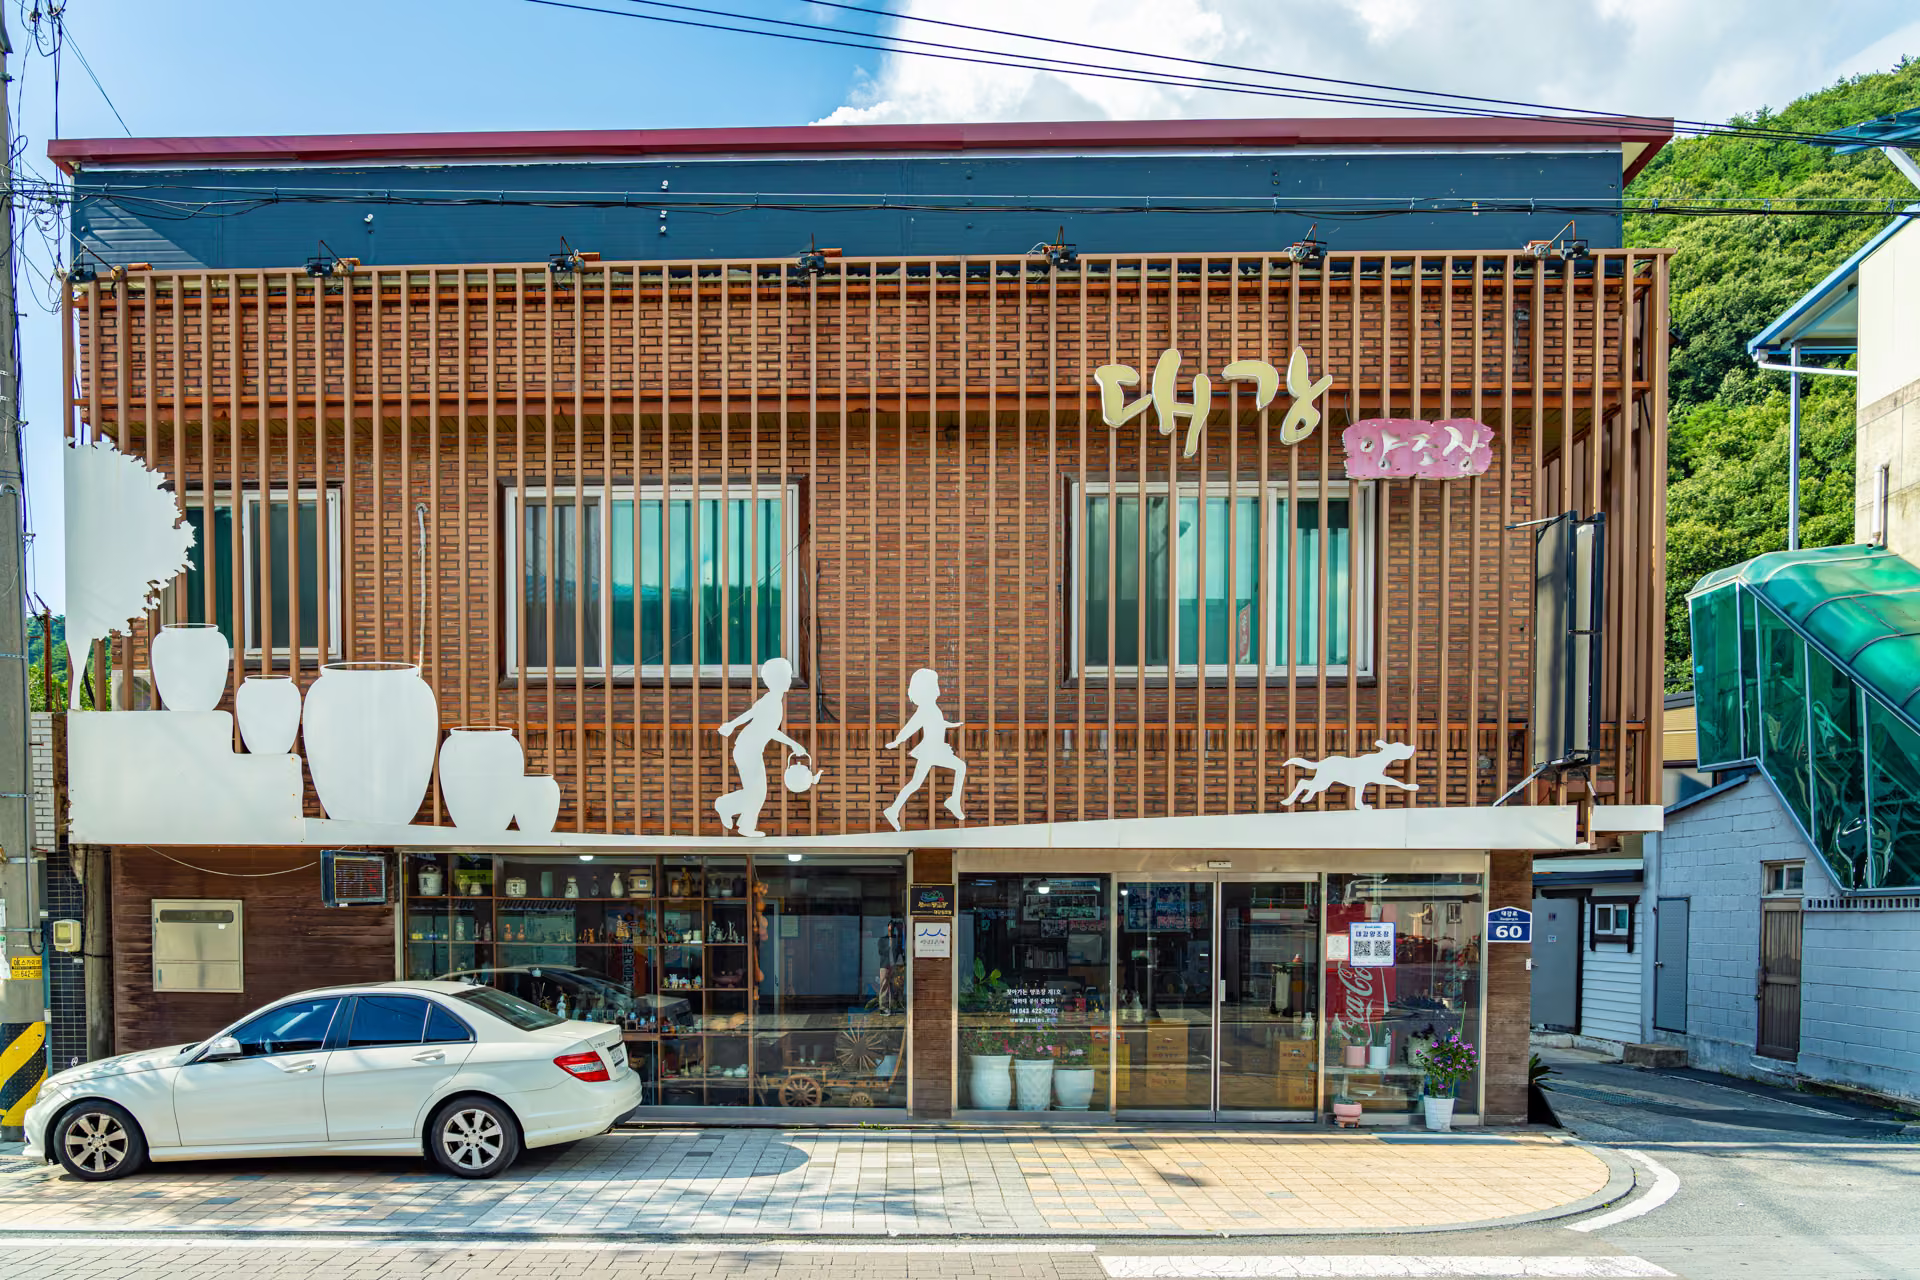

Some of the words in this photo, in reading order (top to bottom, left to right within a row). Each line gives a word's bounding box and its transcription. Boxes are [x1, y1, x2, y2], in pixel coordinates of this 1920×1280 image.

[1094, 346, 1333, 458] 대강
[1359, 425, 1486, 472] 양조장
[1500, 910, 1519, 918] 대강로
[1355, 930, 1390, 938] 대강양조장
[1495, 925, 1523, 939] 60
[1006, 988, 1028, 996] 찾아가는
[1029, 988, 1046, 996] 양조장
